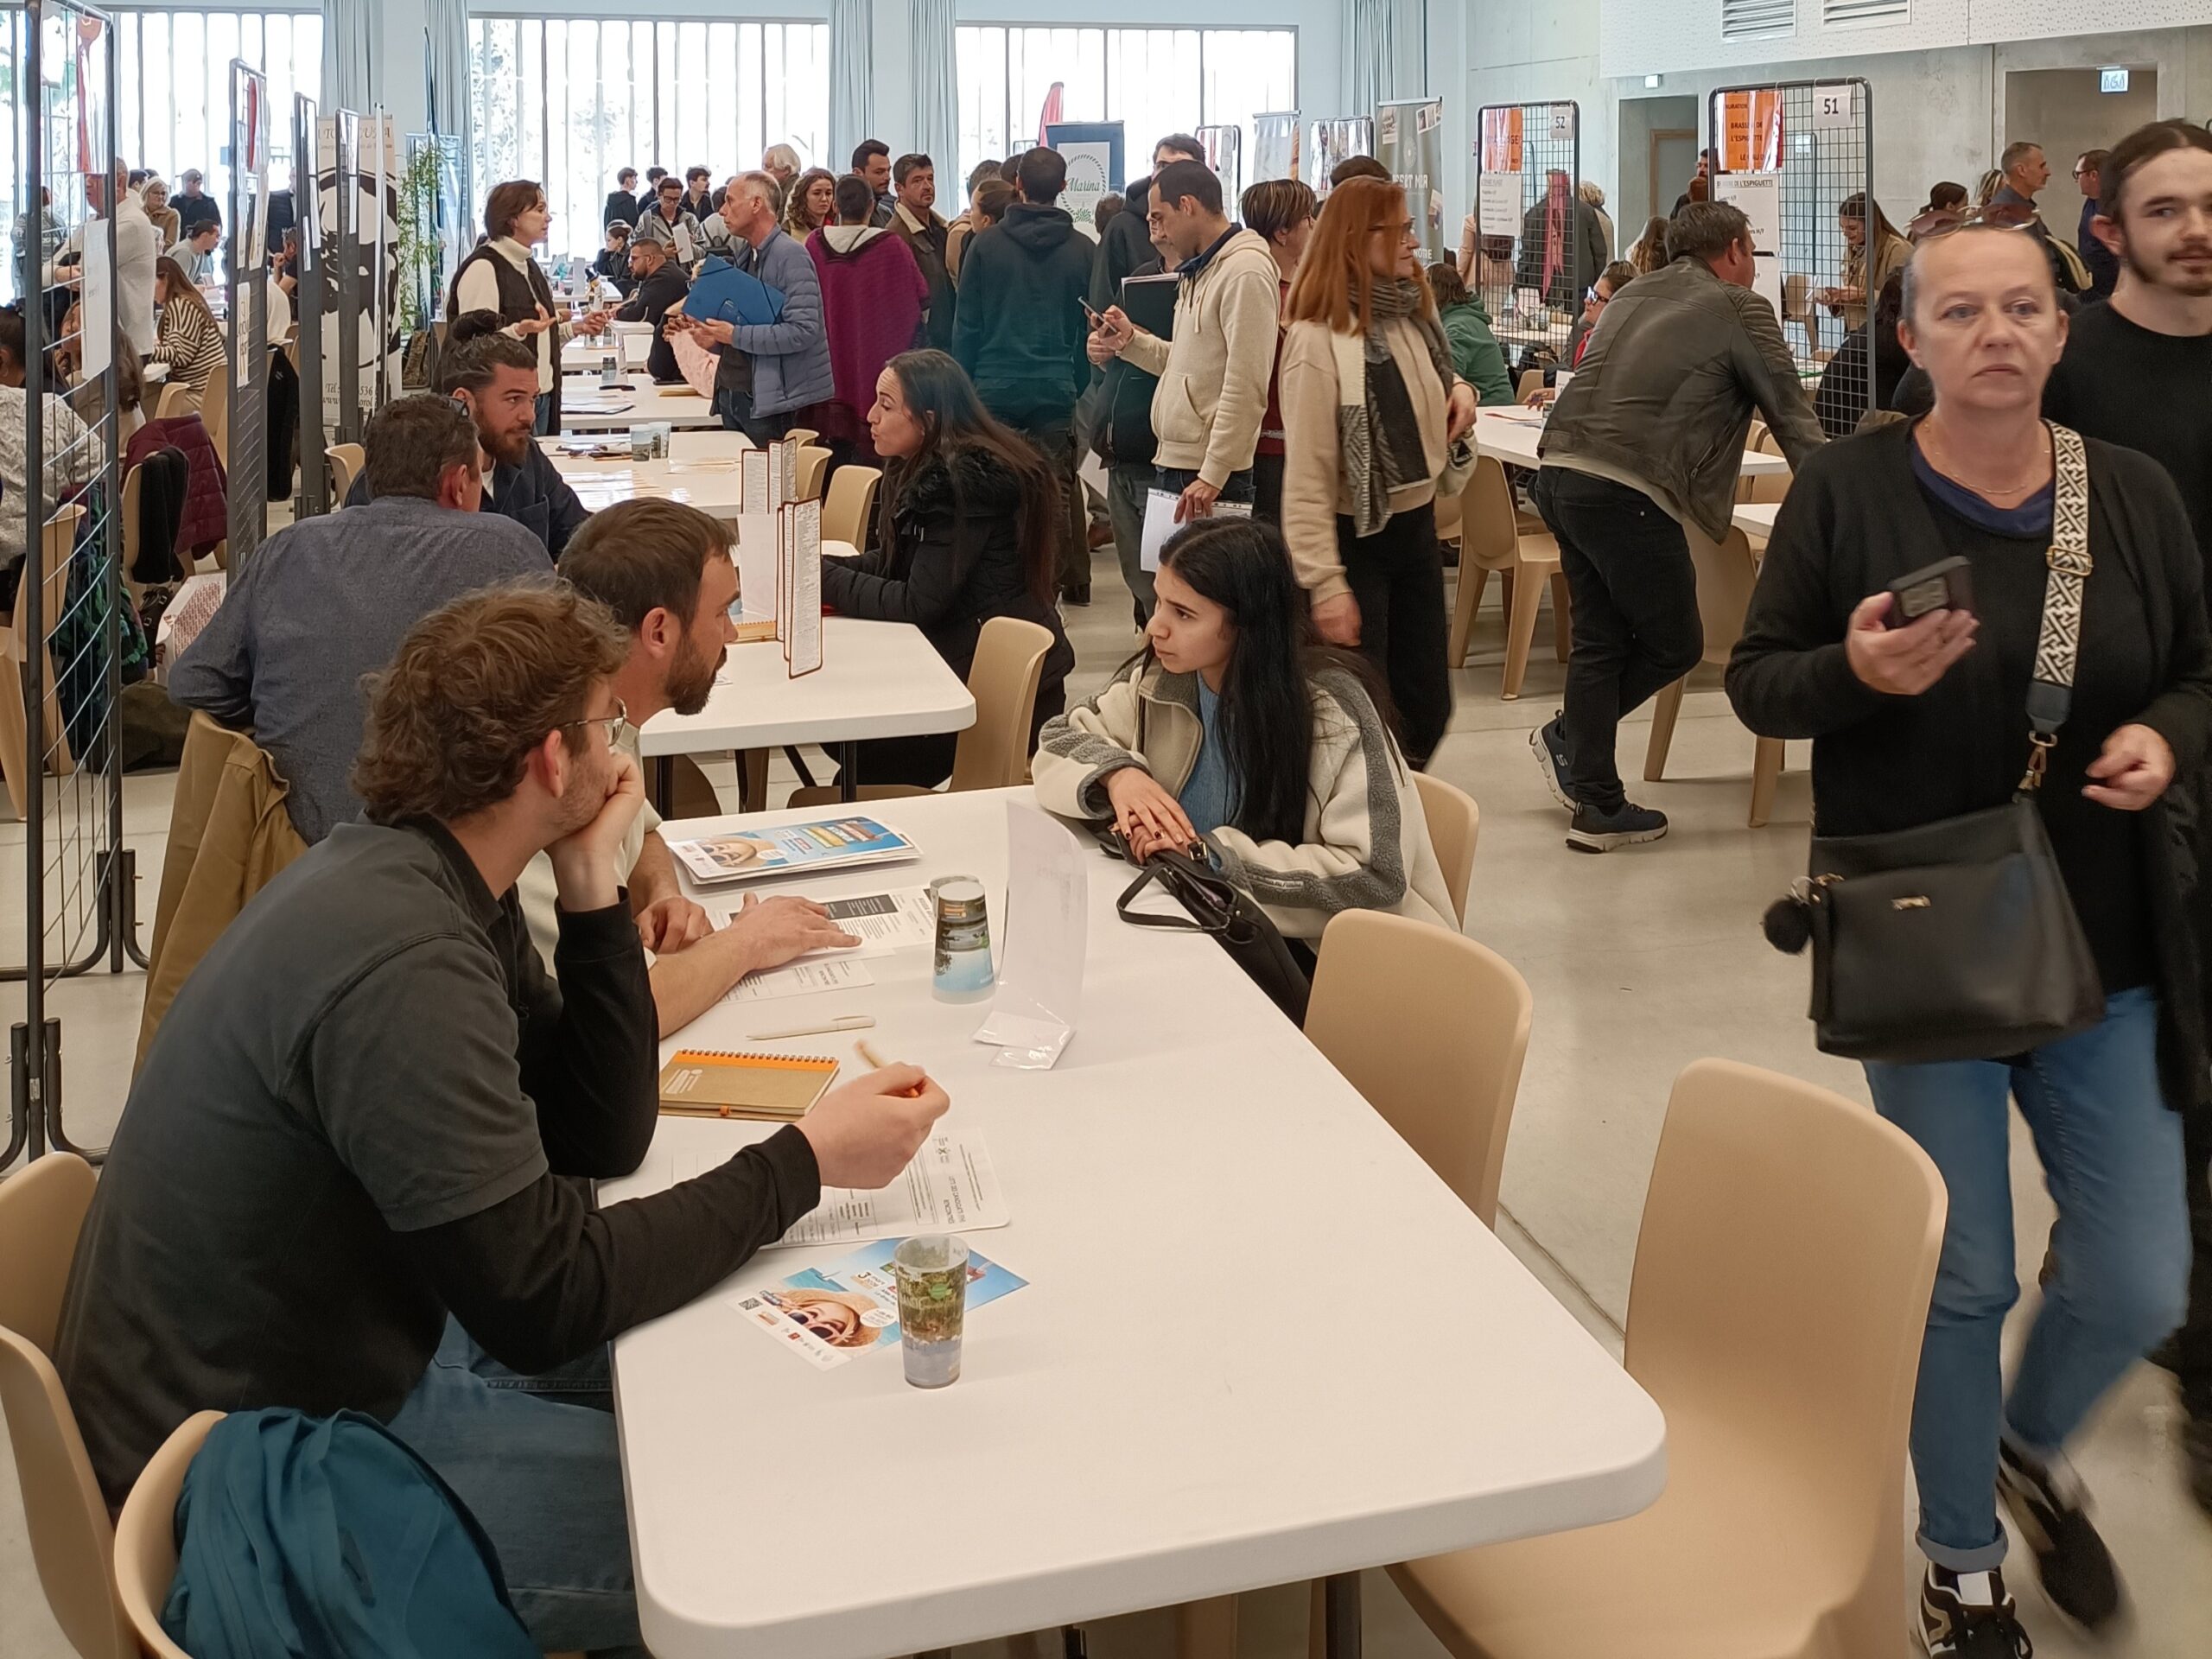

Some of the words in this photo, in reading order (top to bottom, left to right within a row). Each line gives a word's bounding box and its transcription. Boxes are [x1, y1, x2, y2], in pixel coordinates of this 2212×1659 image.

[1823, 98, 1839, 115] 51
[1555, 116, 1566, 129] 52
[1066, 177, 1100, 192] Marina
